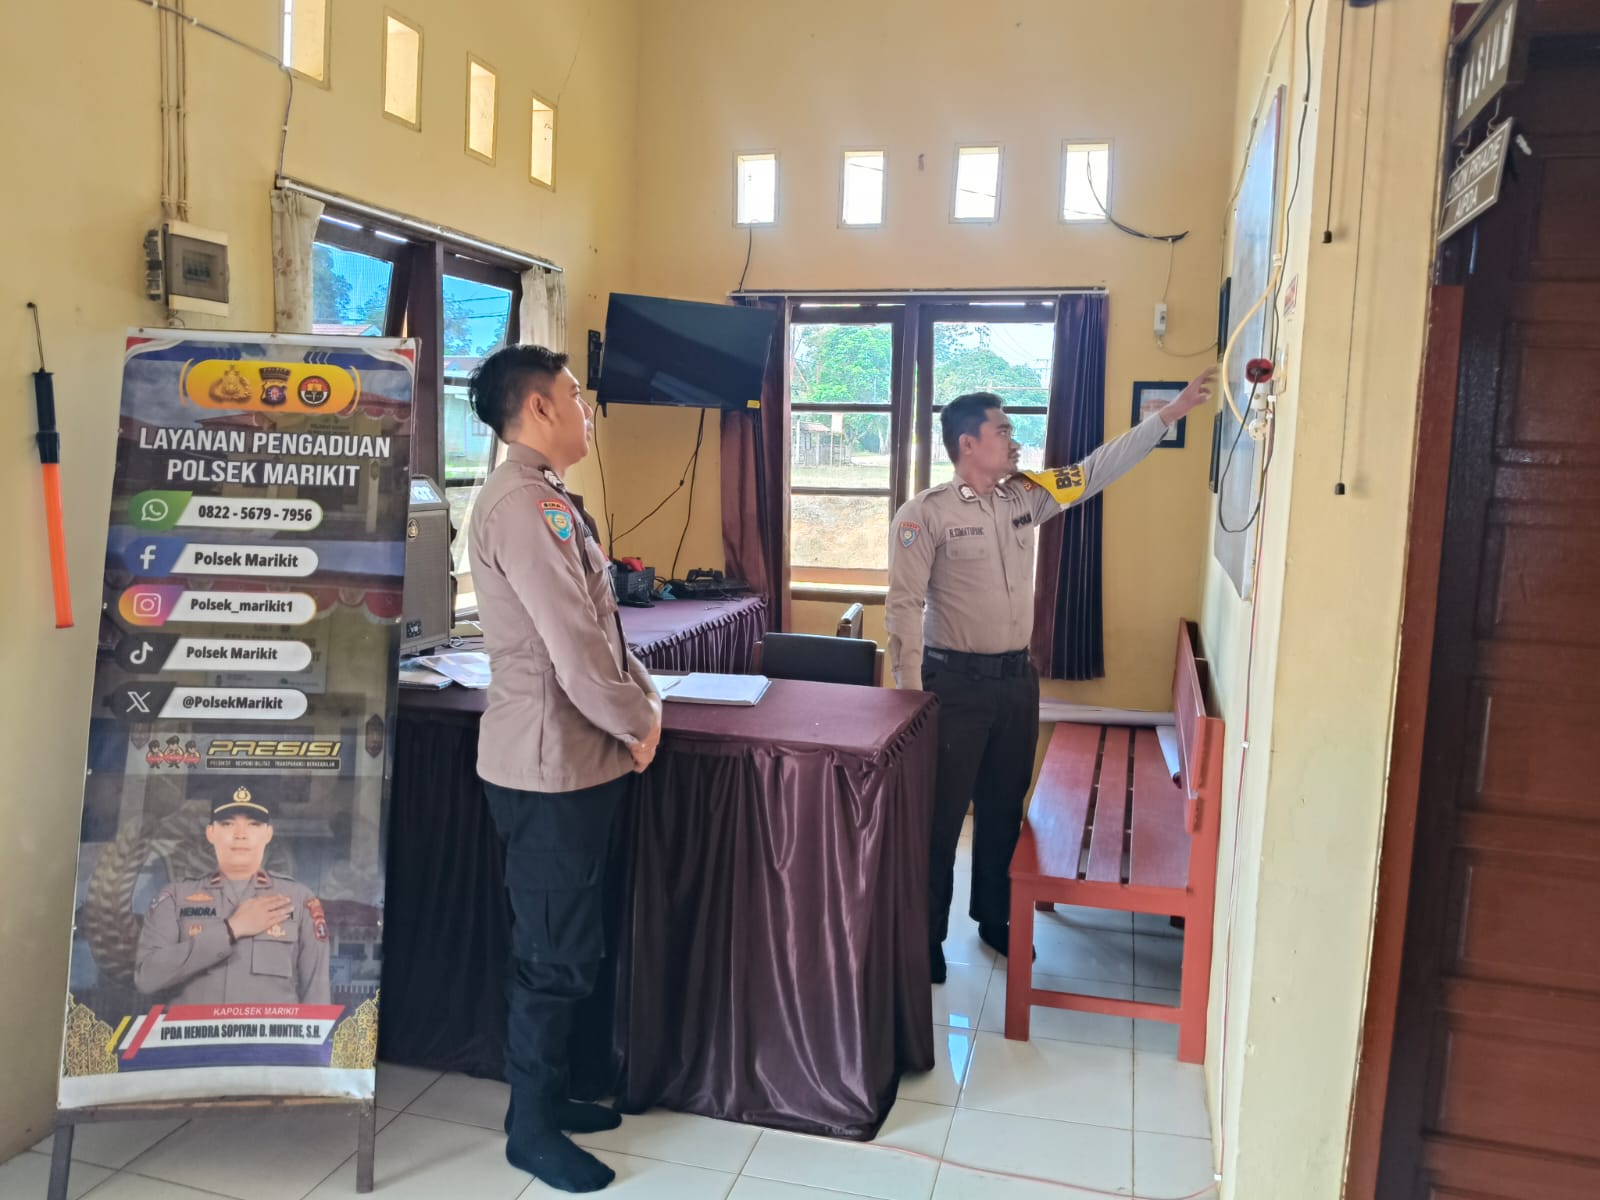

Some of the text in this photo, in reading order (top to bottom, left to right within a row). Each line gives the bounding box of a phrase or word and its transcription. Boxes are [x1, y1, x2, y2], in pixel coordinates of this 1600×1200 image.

[139, 427, 390, 458] LAYANAN PENGADUAN
[167, 459, 360, 487] POLSEK MARIKIT
[198, 505, 230, 520] 0822
[240, 507, 271, 521] 5679
[282, 508, 312, 522] 7956
[194, 552, 298, 567] Polsek Marikit
[190, 598, 293, 614] Polsek_marikit1
[186, 646, 278, 660] Polsek Marikit
[182, 696, 283, 710] @PolsekMarikit
[207, 740, 342, 757] PRESISI
[179, 907, 217, 918] HENDRA
[213, 1007, 300, 1017] KAPOLSEK MARIKIT
[160, 1026, 182, 1041] IPDA
[184, 1025, 220, 1040] HENDRA
[221, 1024, 258, 1039] SOPIYAN
[259, 1024, 268, 1038] D.
[306, 1025, 321, 1039] S.H.
